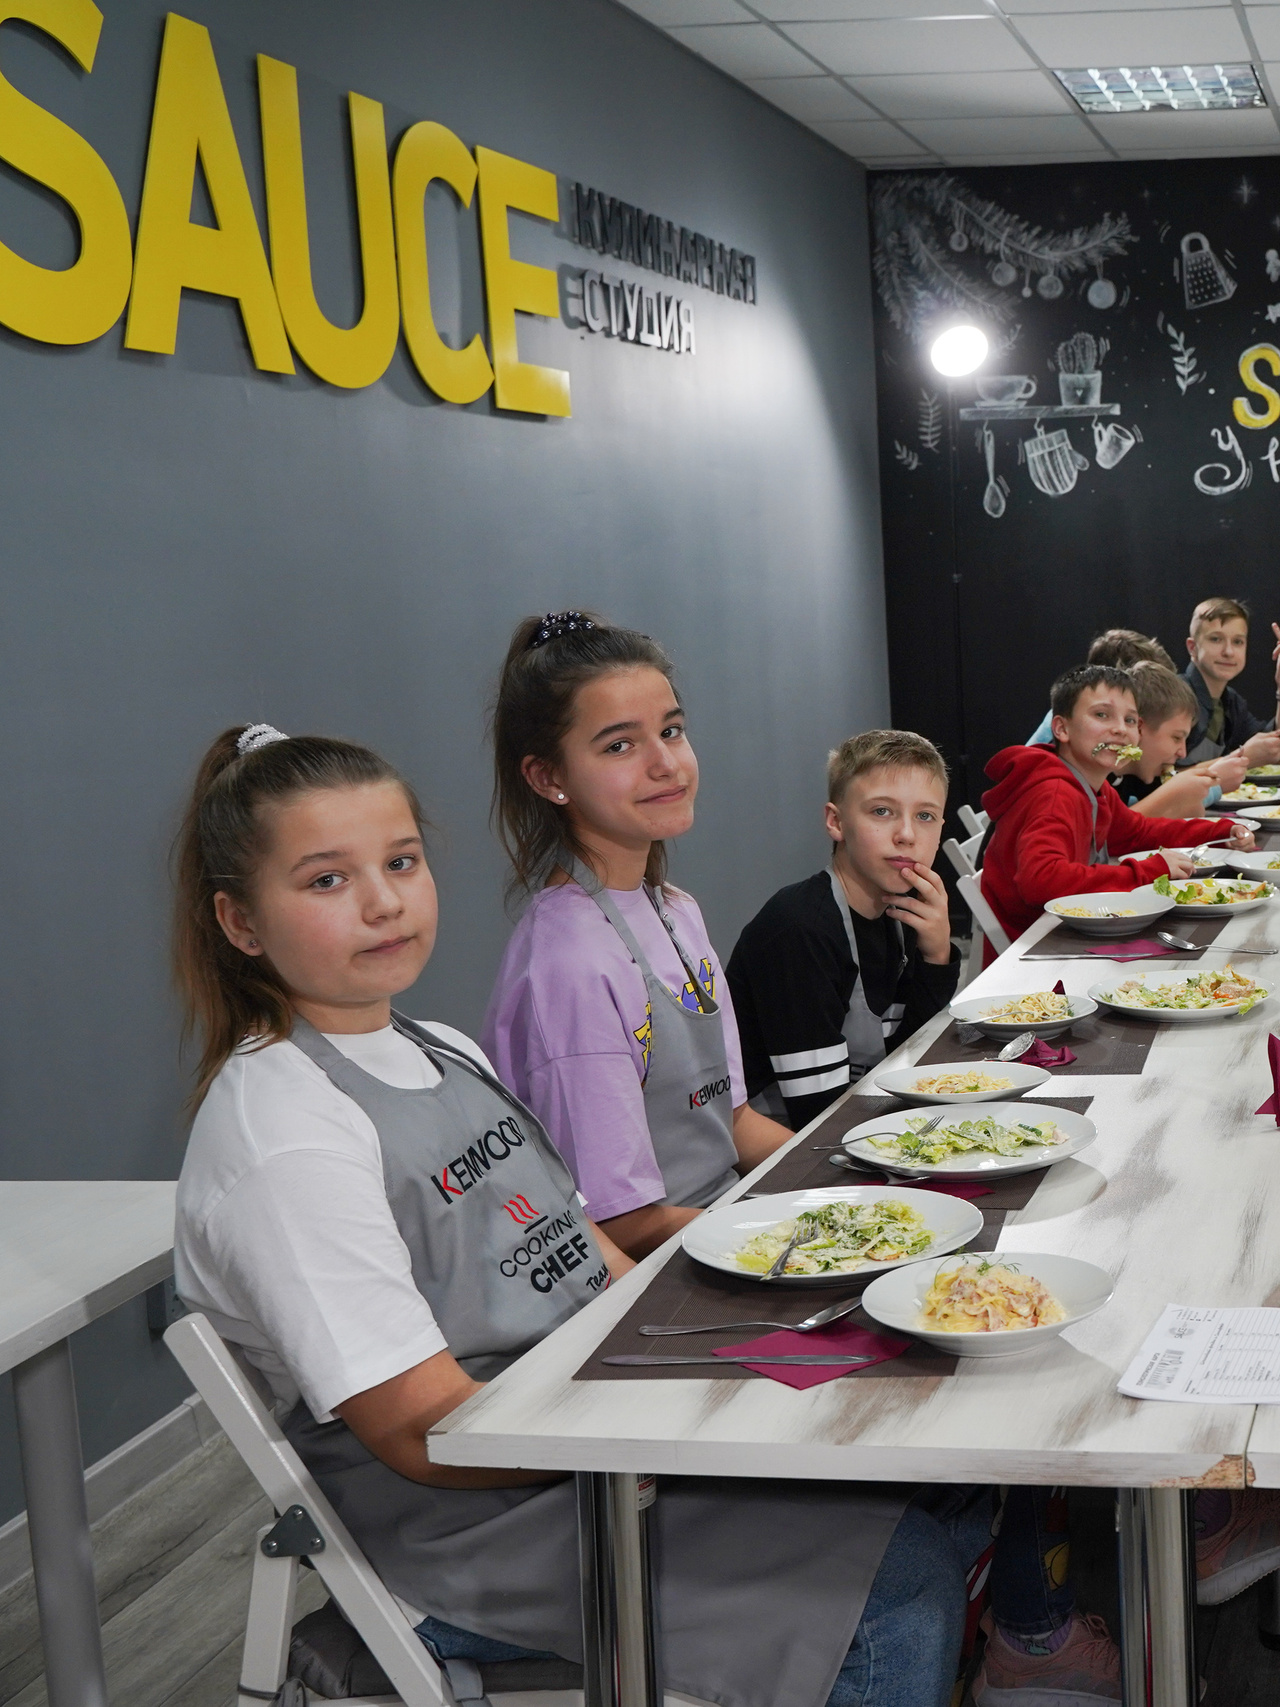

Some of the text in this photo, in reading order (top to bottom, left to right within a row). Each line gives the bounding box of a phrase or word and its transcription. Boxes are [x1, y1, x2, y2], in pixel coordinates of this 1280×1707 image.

[0, 0, 572, 418] SAUCE
[574, 181, 757, 306] КУЛИНАРНАЯ
[582, 267, 696, 355] СТУДИЯ
[530, 1232, 590, 1294] CHEF
